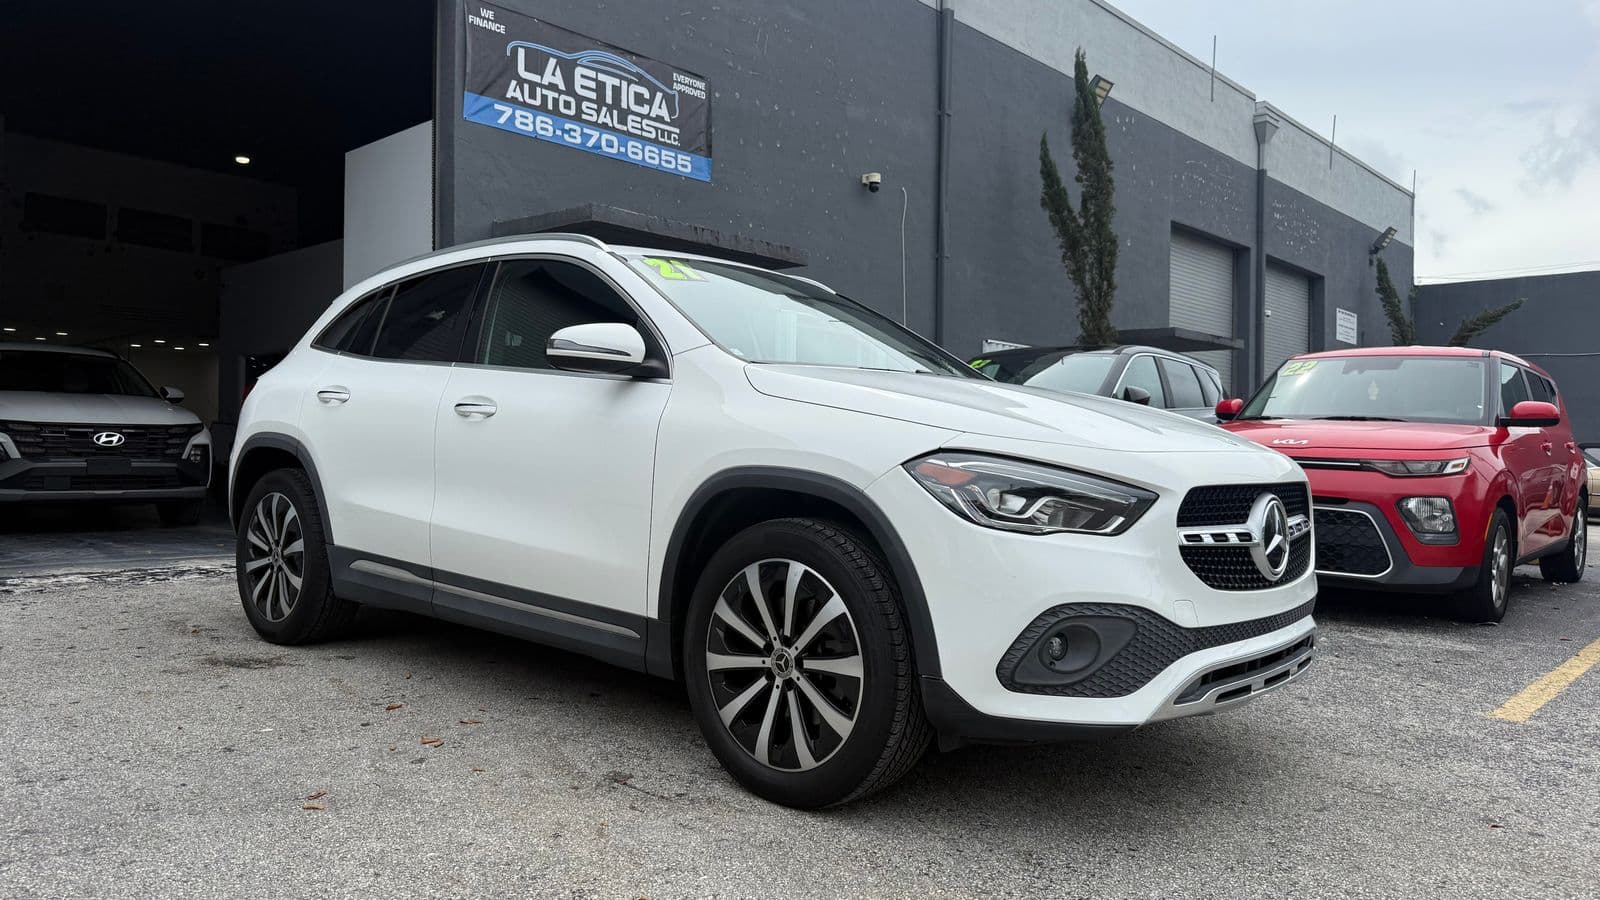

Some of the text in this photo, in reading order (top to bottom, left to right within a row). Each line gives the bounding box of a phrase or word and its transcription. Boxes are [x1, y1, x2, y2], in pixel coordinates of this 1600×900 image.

[481, 7, 494, 20] WE
[468, 14, 506, 34] FINANCE
[518, 47, 671, 122] LA ETICA
[673, 72, 706, 91] EVERYONE
[673, 82, 706, 99] APPROVED
[505, 79, 576, 116] AUTO
[581, 101, 659, 140] SALES
[494, 104, 692, 174] 786-370-6655
[1281, 360, 1318, 377] 22
